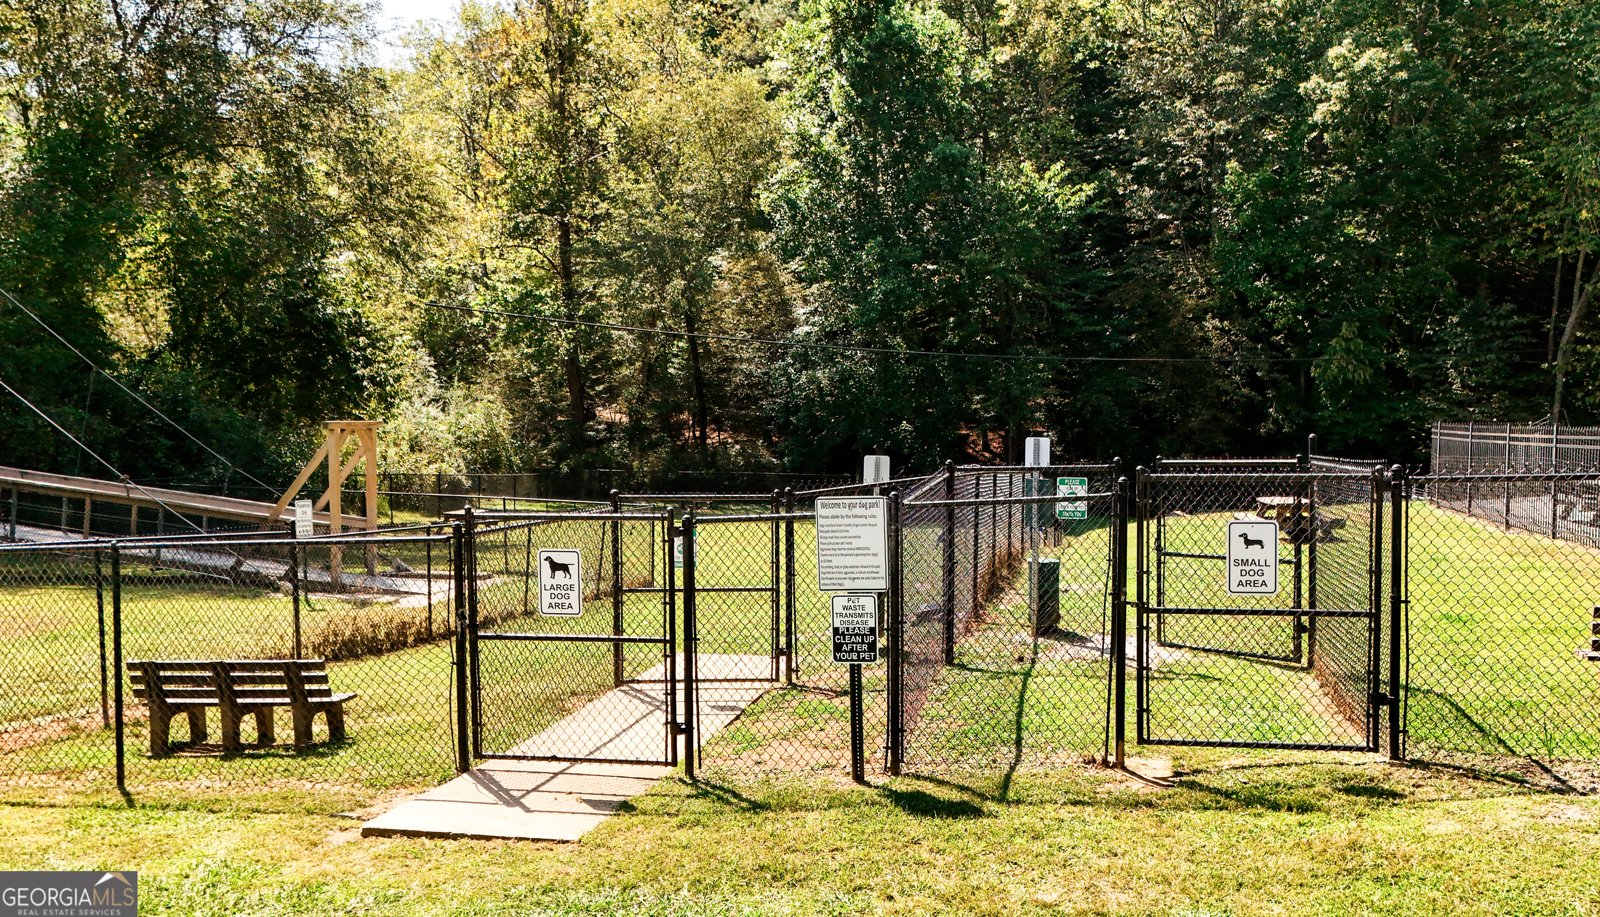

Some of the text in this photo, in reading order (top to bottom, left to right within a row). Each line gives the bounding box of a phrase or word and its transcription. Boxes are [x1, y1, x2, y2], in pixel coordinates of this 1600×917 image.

[820, 500, 880, 510] Welcome to your dog park!
[1233, 559, 1271, 567] SMALL
[1240, 569, 1265, 577] DOG
[835, 652, 875, 660] YOUR PET
